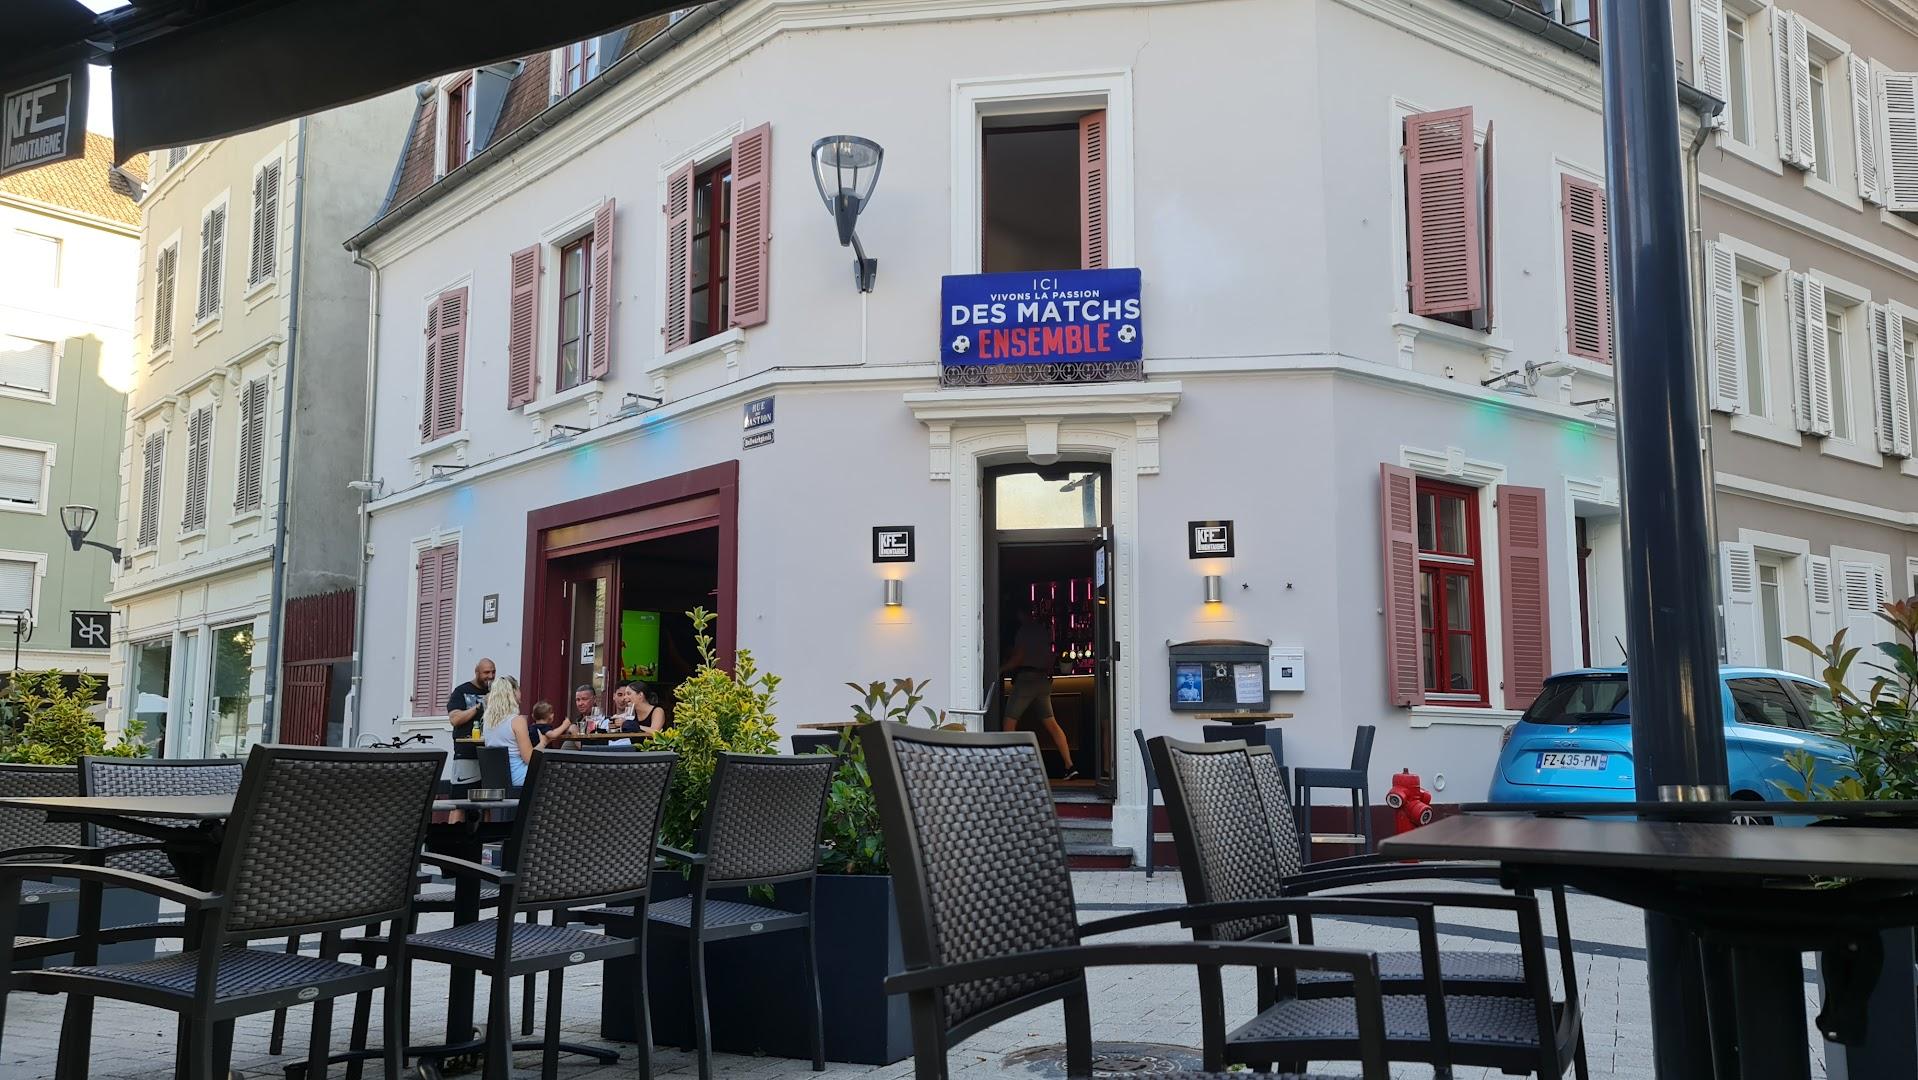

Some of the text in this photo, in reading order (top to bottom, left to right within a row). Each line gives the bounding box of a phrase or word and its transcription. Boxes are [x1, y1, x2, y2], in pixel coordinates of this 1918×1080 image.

[6, 85, 65, 167] KFE
[10, 132, 61, 165] MONTAIGNE
[1033, 278, 1058, 290] ICI
[990, 289, 1100, 302] VIVONS LA PASSION
[951, 299, 1141, 326] DES MATCHS
[978, 323, 1111, 359] ENSEMBLE
[752, 401, 766, 413] RUE
[745, 413, 772, 427] ASTION
[880, 534, 907, 555] KFE
[1197, 528, 1226, 550] KFE
[1543, 754, 1599, 767] FZ-435-PN
